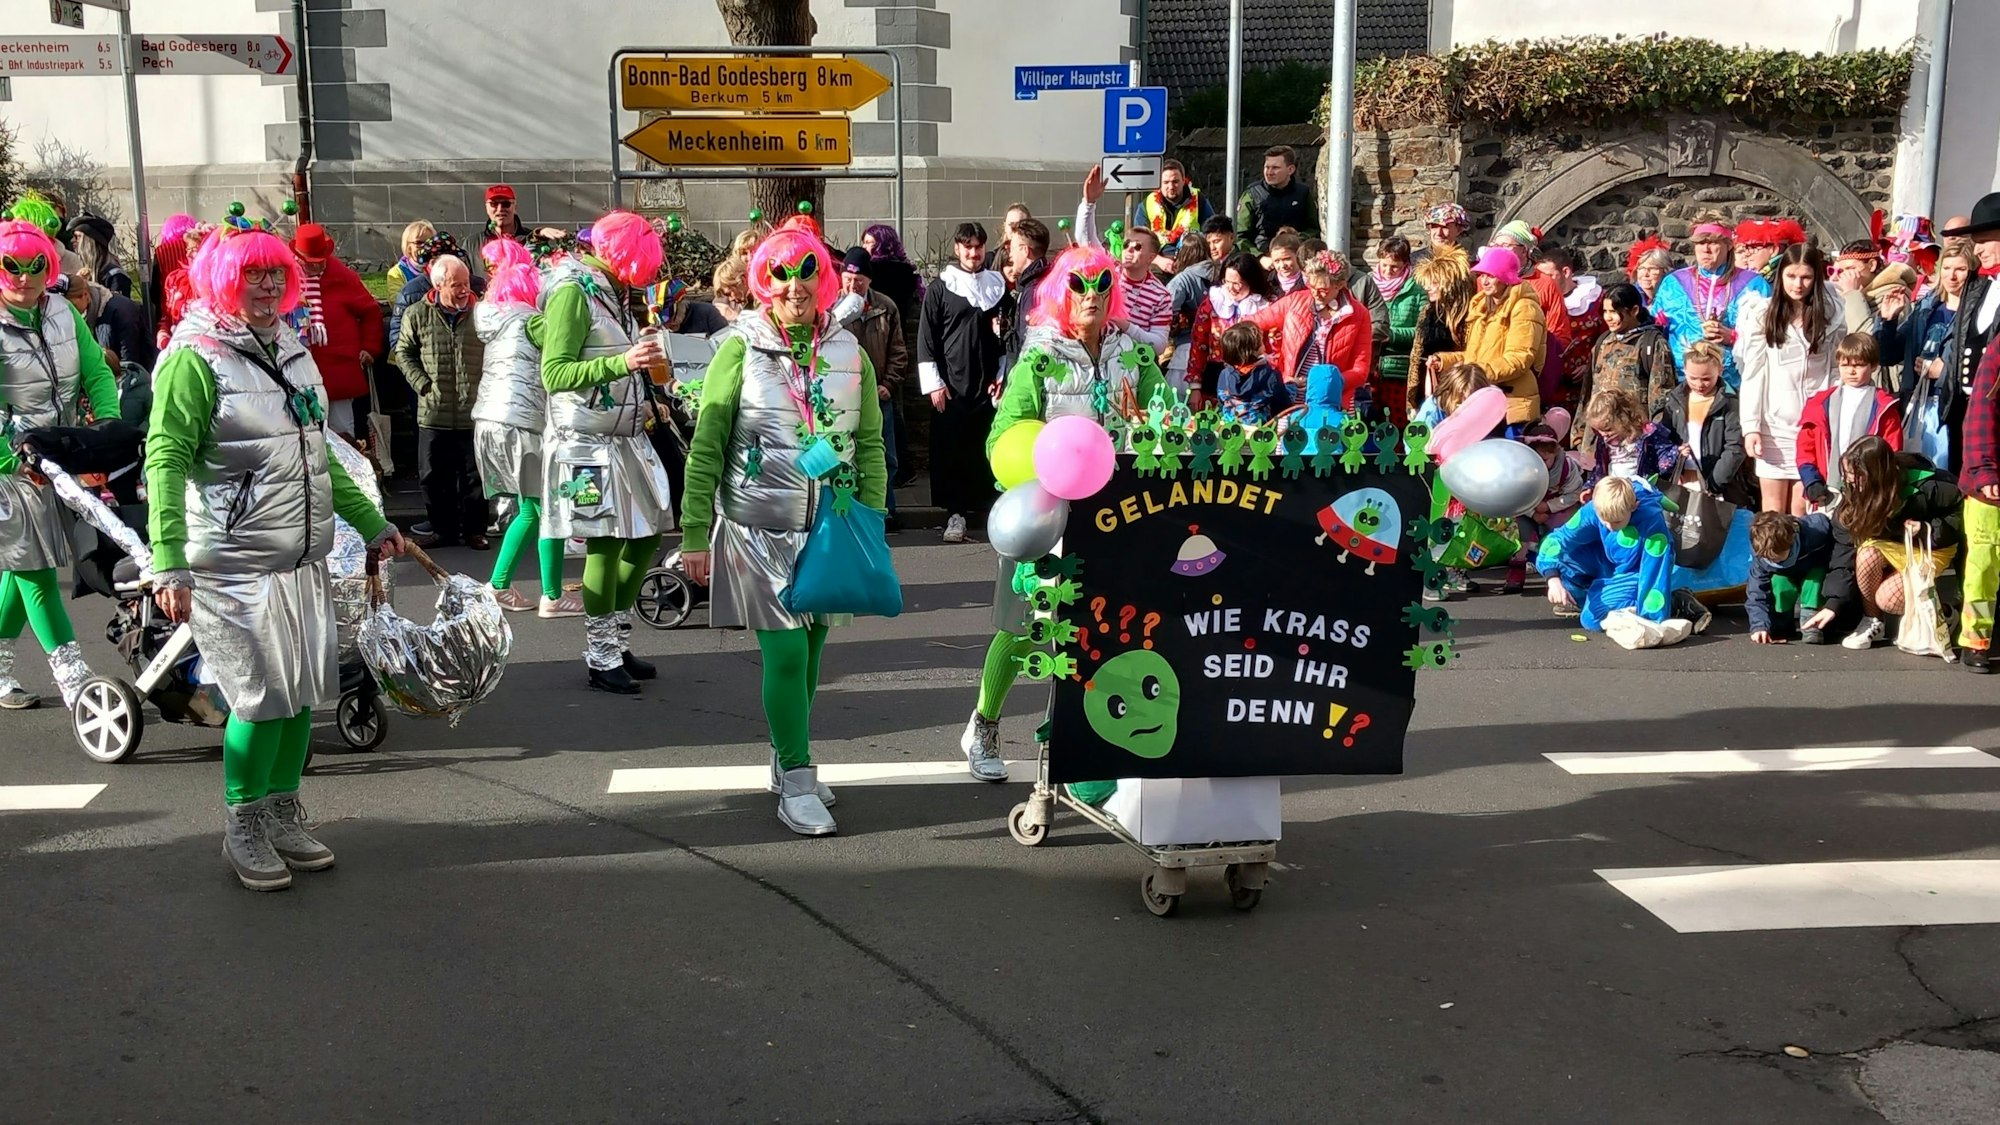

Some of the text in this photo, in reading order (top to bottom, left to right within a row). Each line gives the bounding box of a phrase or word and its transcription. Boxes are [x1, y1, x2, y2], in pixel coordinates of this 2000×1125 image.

[141, 40, 165, 52] Bad
[169, 40, 237, 54] Godesberg
[27, 60, 84, 71] Industriepark
[142, 57, 174, 68] Pech
[628, 65, 853, 91] Bonn-Bad Godesberg 8 km
[1021, 70, 1124, 88] Villiper Hauptstr.
[691, 90, 793, 103] Berkum 5 km
[1118, 97, 1151, 145] P
[669, 130, 784, 151] Meckenheim
[798, 130, 807, 150] 6
[1095, 479, 1283, 533] GELANDET
[1184, 608, 1371, 649] WIE KRASS
[1203, 653, 1349, 689] SEID IHR
[1226, 698, 1314, 726] DENN
